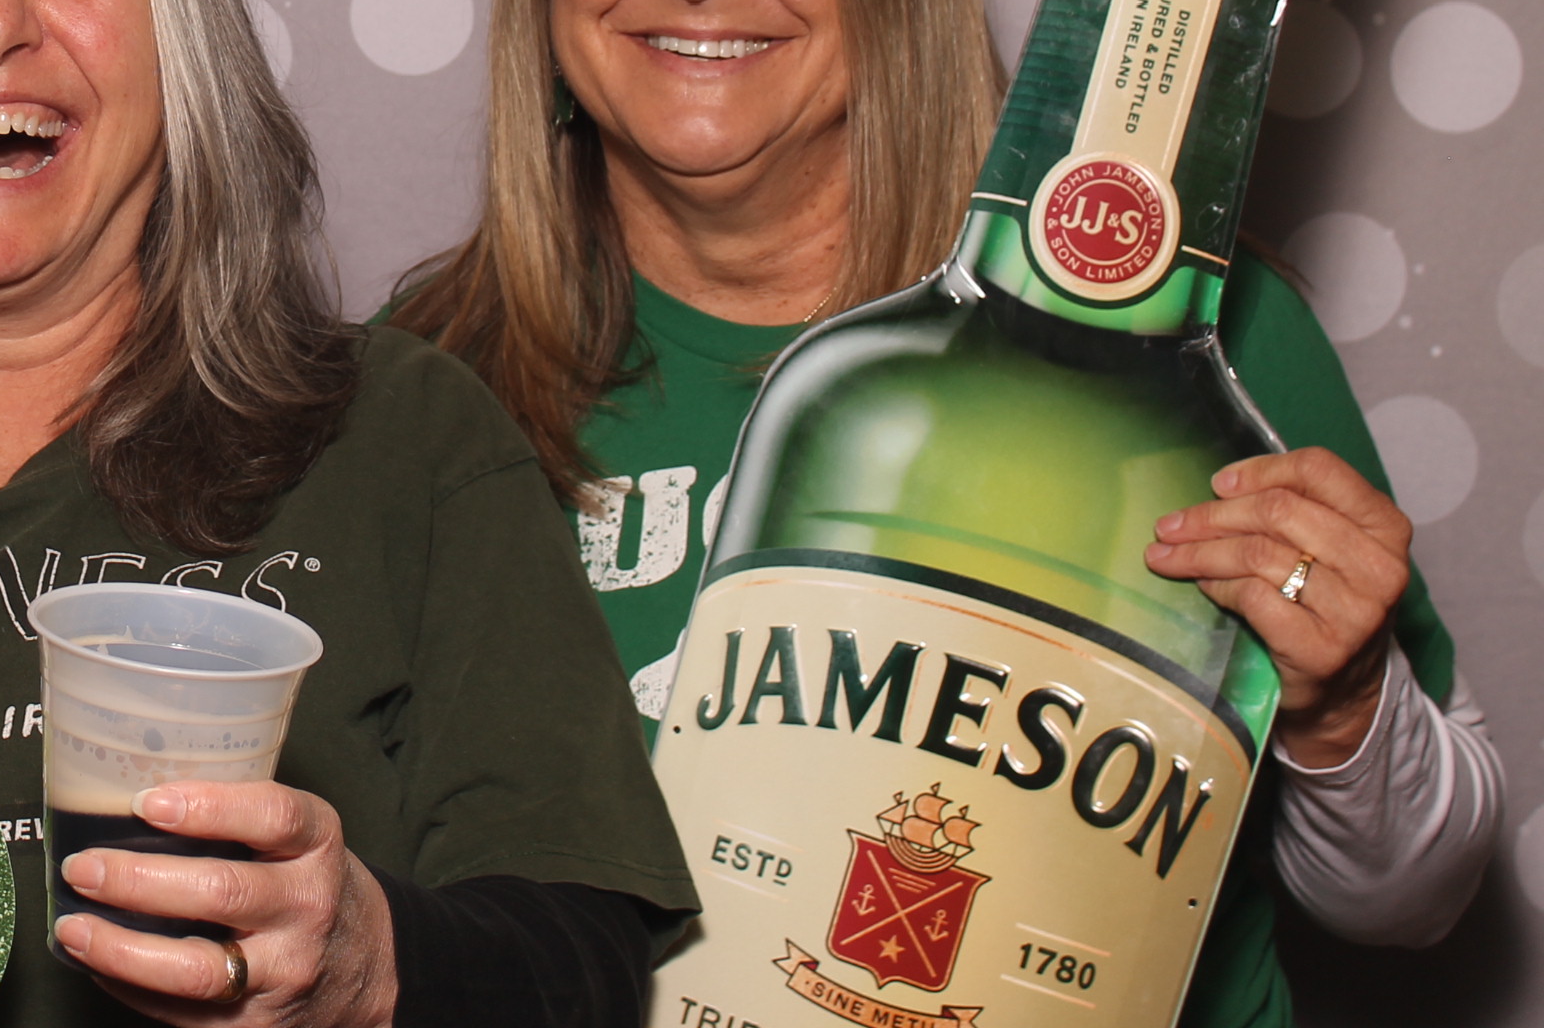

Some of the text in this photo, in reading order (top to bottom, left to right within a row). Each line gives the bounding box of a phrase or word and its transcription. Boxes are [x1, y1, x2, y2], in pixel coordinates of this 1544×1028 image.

[1115, 14, 1145, 89] IRELAND
[1146, 43, 1159, 54] &
[1158, 9, 1191, 94] DISTILLED
[1125, 59, 1155, 134] BOTTLED
[1054, 165, 1162, 230] JOHN JAMESON
[1060, 195, 1144, 245] JJ&S
[1050, 237, 1080, 270] SON
[1085, 245, 1154, 279] LIMITED
[695, 623, 1213, 879] JAMESON
[711, 835, 793, 886] ESTD
[1019, 942, 1097, 990] 1780
[812, 981, 864, 1017] SINE
